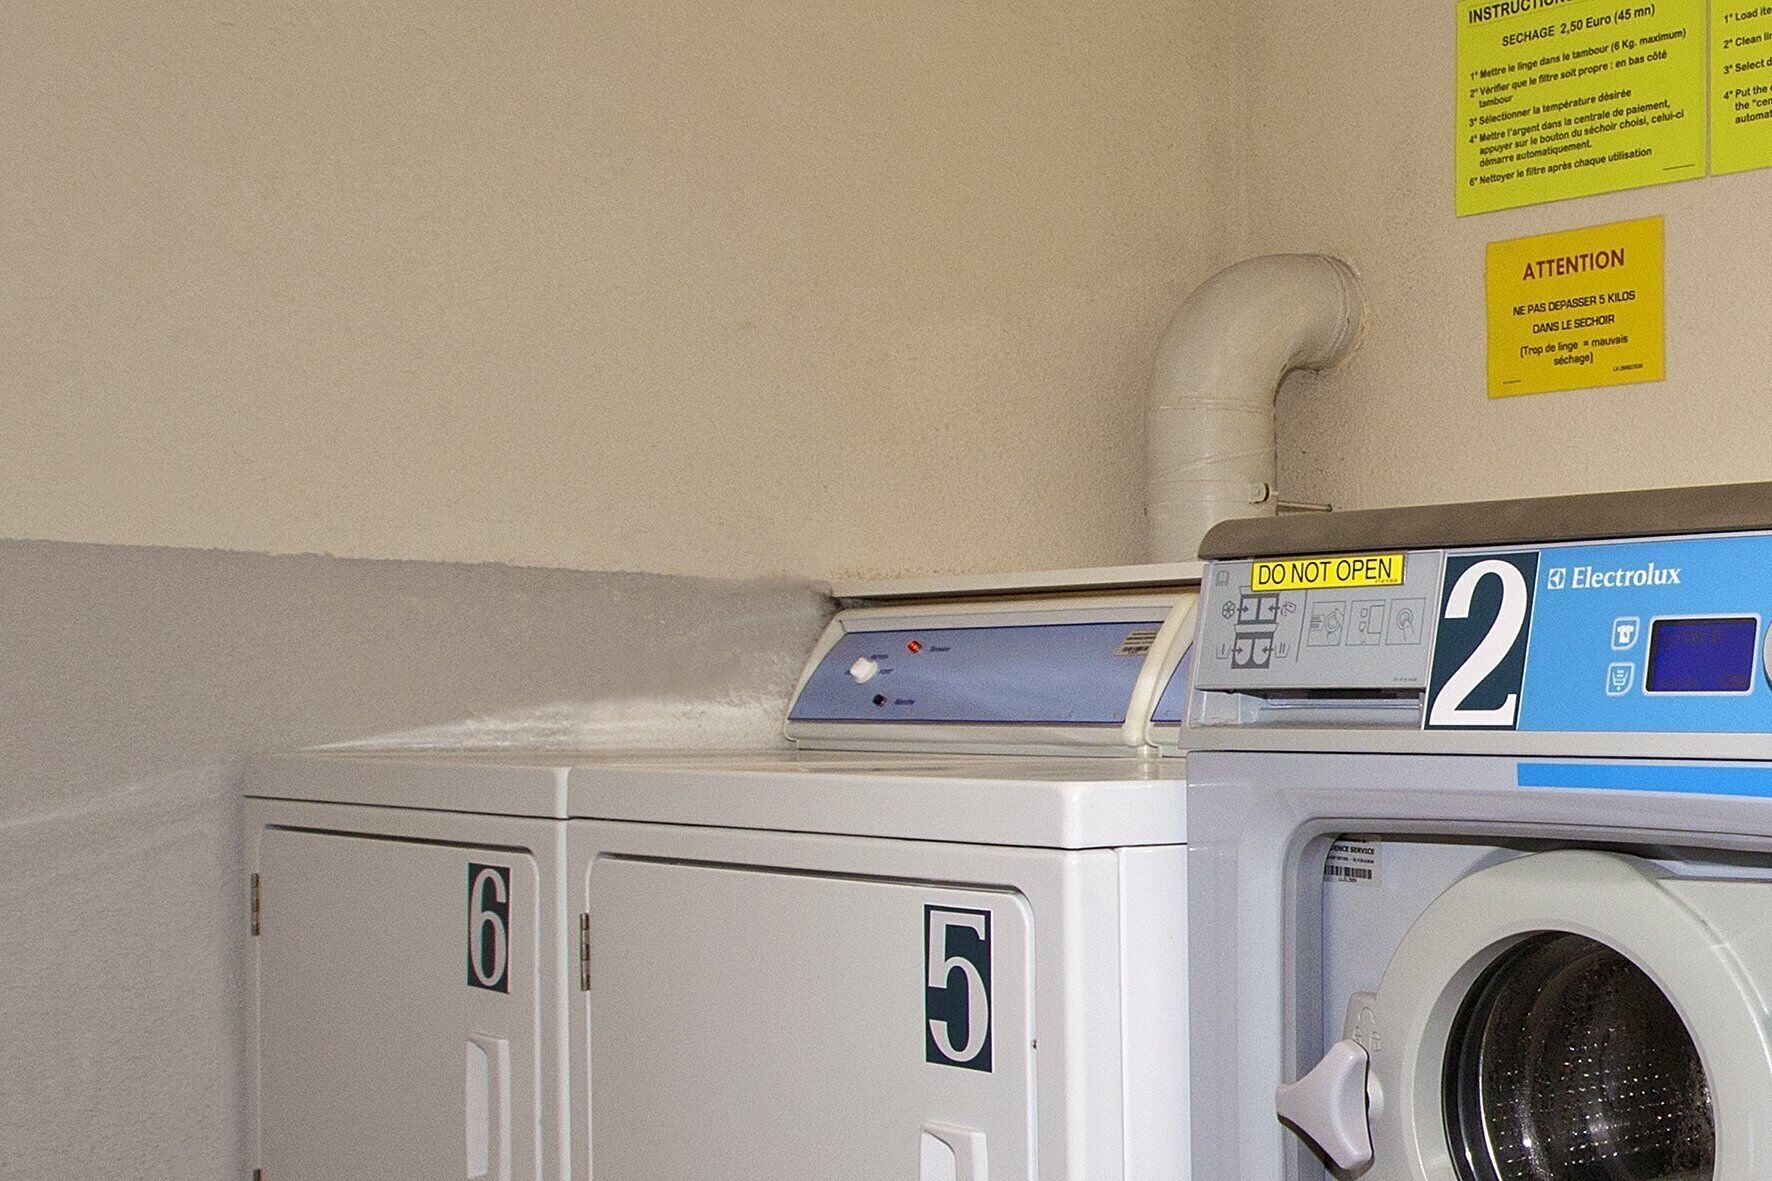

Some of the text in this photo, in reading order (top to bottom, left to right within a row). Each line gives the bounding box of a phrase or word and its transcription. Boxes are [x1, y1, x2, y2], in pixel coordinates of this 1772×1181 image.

[1502, 3, 1655, 46] SECHAGE 2,50 Euro (45 mn)
[1735, 9, 1758, 21] Load
[1479, 66, 1506, 78] Mettre
[1507, 64, 1515, 72] le
[1517, 60, 1537, 70] linge
[1539, 55, 1560, 66] dans
[1562, 52, 1570, 61] le
[1571, 45, 1609, 59] tambour
[1610, 41, 1619, 52] (6
[1621, 39, 1638, 49] Kg.
[1639, 28, 1686, 45] maximum)
[1734, 35, 1761, 46] Clean
[1734, 58, 1764, 72] Select
[1735, 87, 1751, 98] Put
[1752, 85, 1767, 95] the
[1734, 101, 1749, 111] the
[1522, 247, 1624, 281] ATTENTION
[1512, 305, 1525, 315] NE
[1527, 302, 1546, 314] PAS
[1548, 295, 1596, 311] DEPASSER
[1607, 290, 1635, 303] KILOS
[1532, 314, 1614, 334] DANS LE SECHOIR
[1520, 345, 1543, 358] (Trop
[1544, 343, 1555, 352] de
[1557, 341, 1578, 352] linge
[1591, 334, 1628, 347] mauvais
[1553, 351, 1593, 365] séchage)
[1258, 558, 1393, 585] DO NOT OPEN
[1571, 563, 1681, 589] Electrolux
[1429, 559, 1528, 726] 2
[470, 868, 507, 987] 6
[928, 909, 989, 1062] 5
